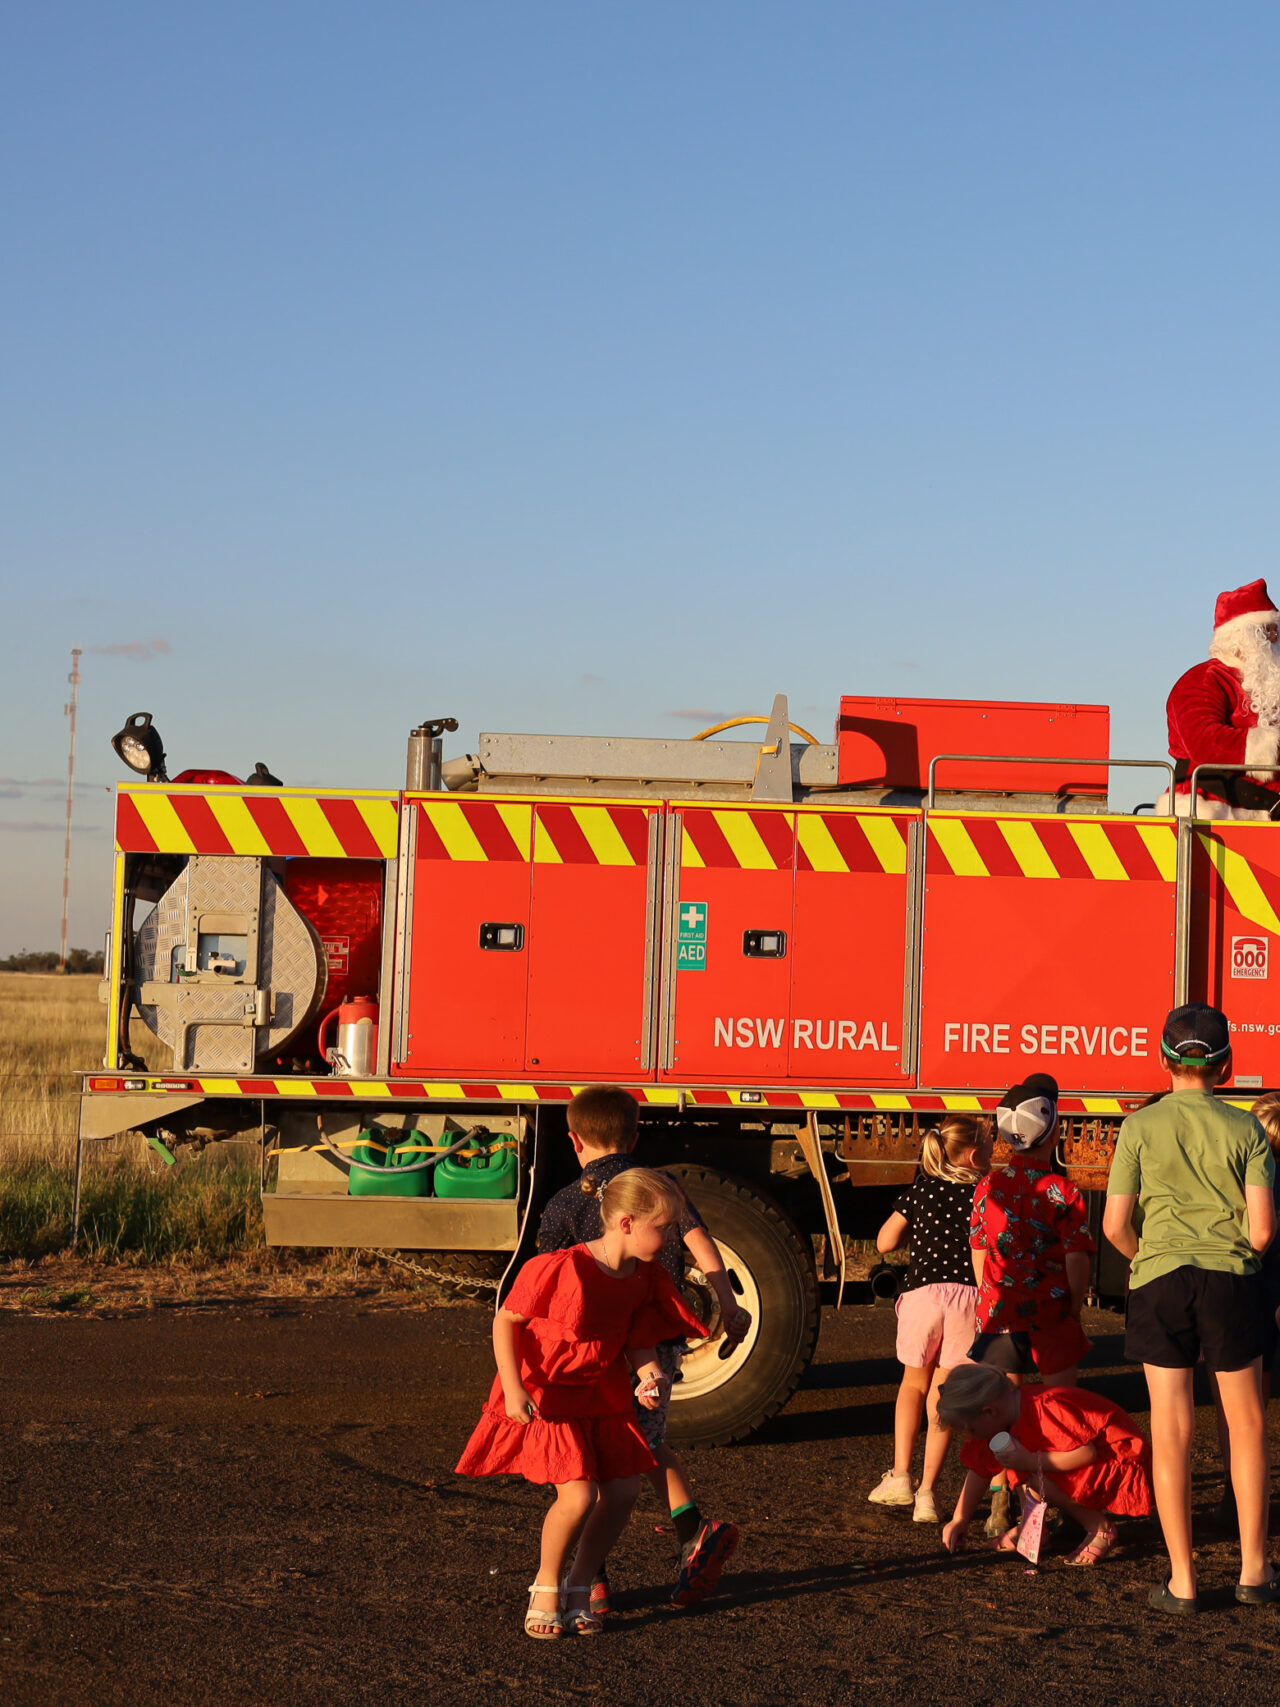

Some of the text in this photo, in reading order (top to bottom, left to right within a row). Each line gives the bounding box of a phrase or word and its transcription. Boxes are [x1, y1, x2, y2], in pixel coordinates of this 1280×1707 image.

[679, 945, 705, 961] AED
[1233, 968, 1266, 977] EMERGENCY
[714, 1017, 785, 1049] NSW
[793, 1019, 898, 1051] RURAL
[944, 1022, 1011, 1053] FIRE
[1020, 1024, 1148, 1057] SERVICE
